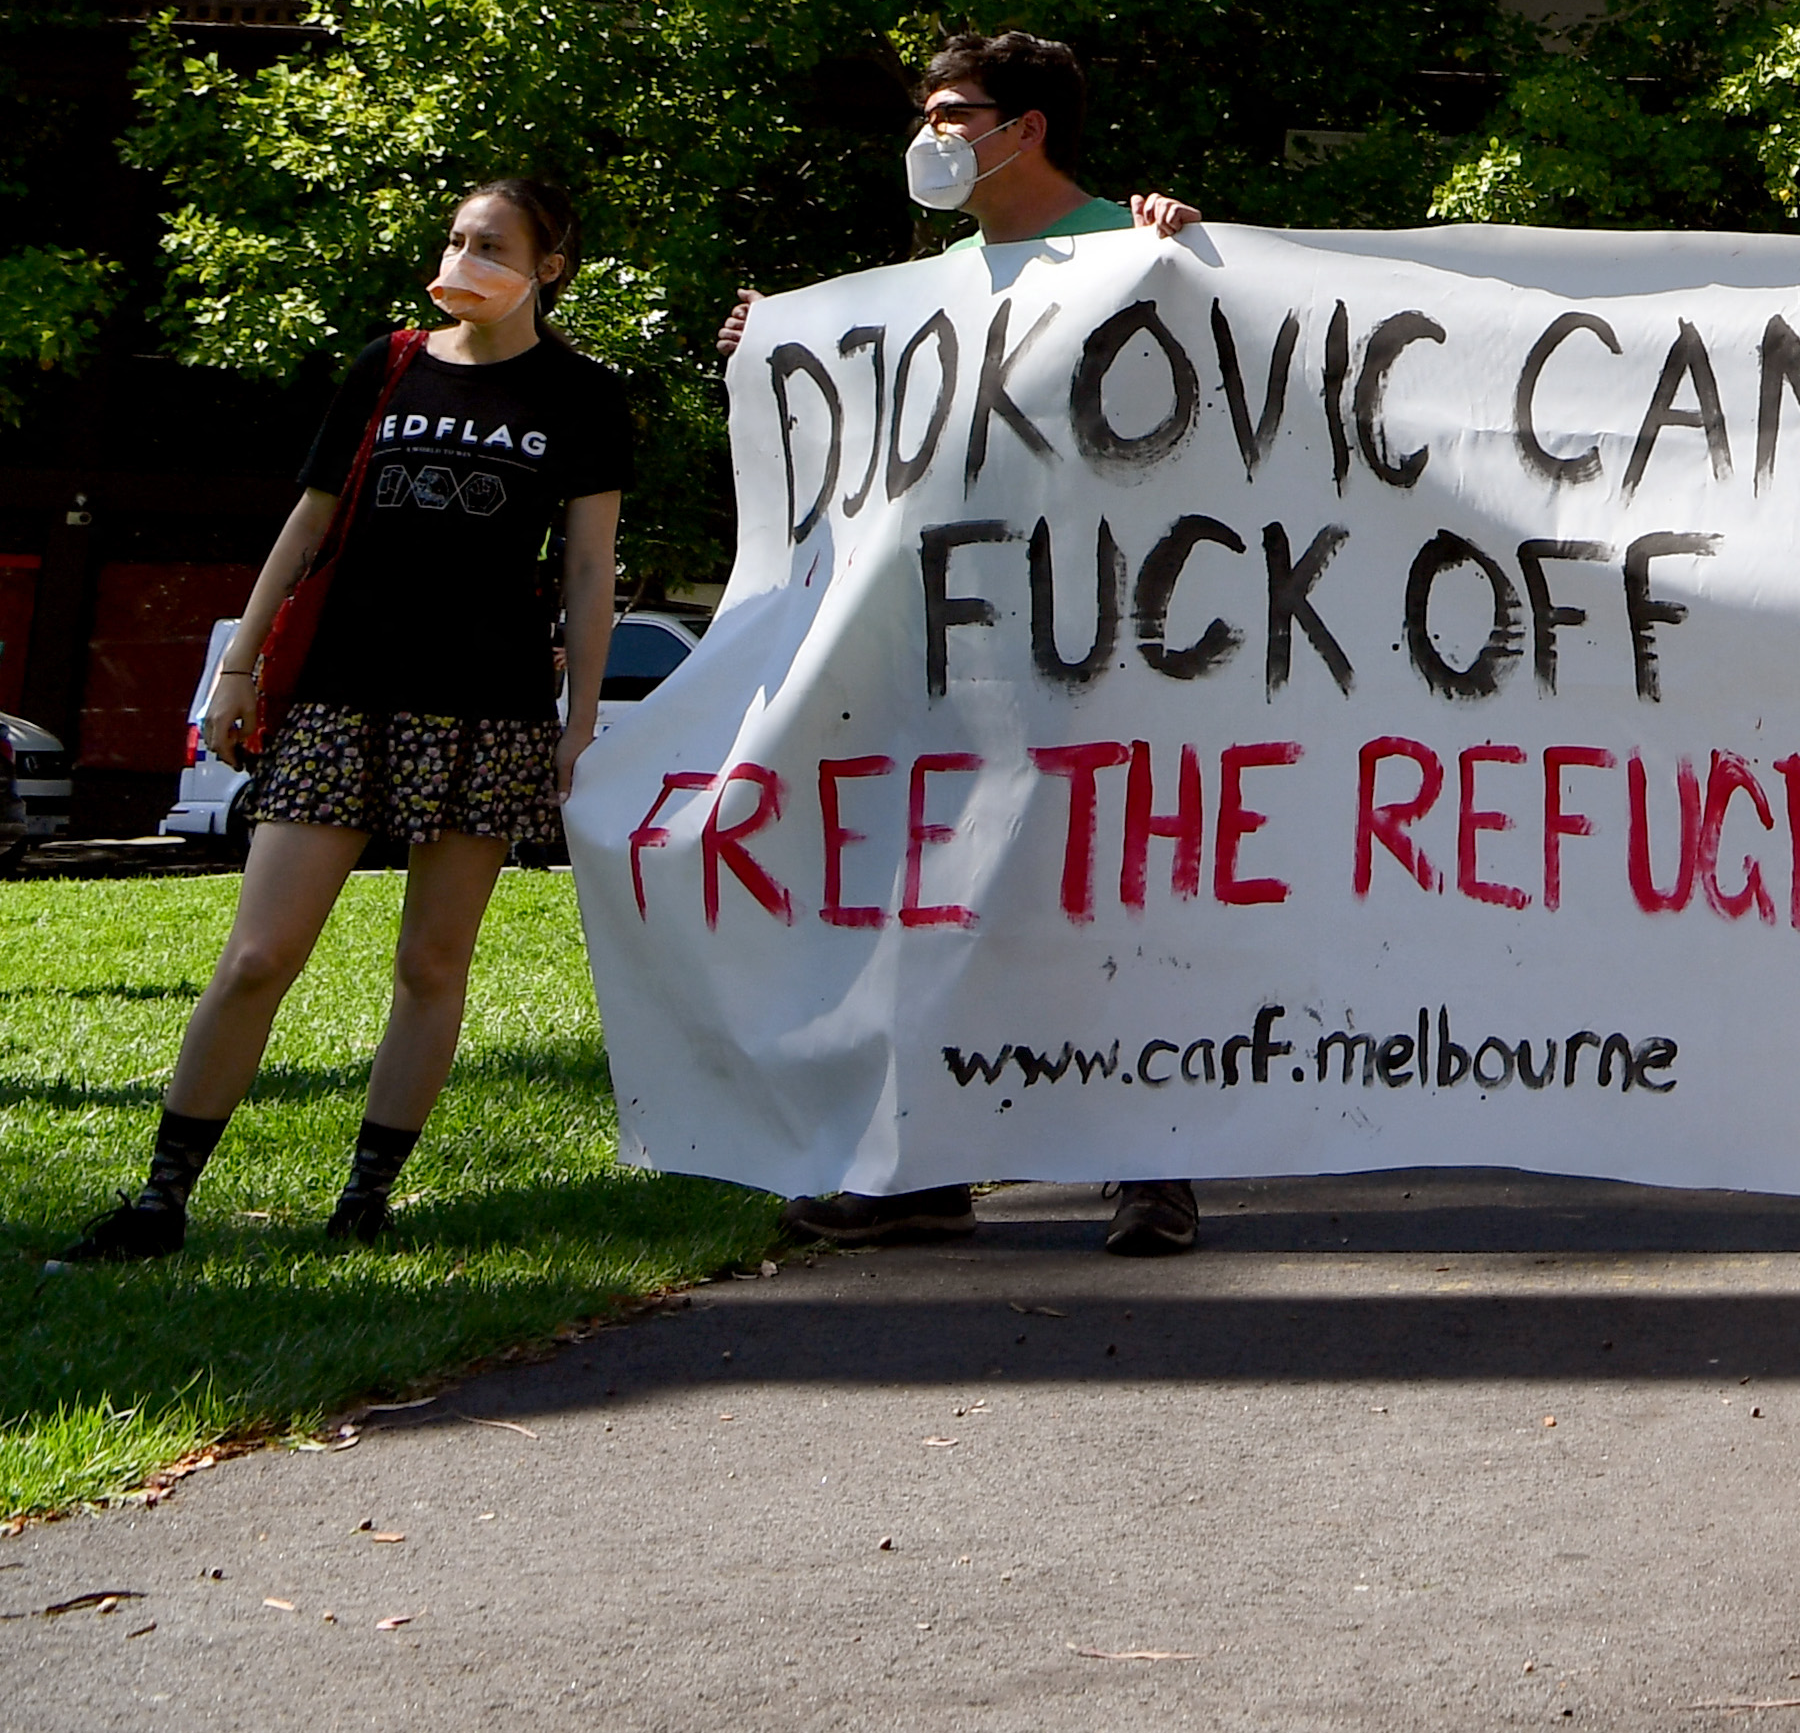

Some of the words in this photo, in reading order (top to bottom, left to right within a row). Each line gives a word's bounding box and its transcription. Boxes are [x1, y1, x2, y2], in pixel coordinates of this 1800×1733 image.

[769, 296, 1448, 546] DJOKOVIC
[919, 512, 1356, 701] FUCK
[1402, 527, 1724, 703] OFF
[627, 752, 983, 931] FREE
[1028, 739, 1305, 925] THE
[941, 1004, 1679, 1093] www.carf.melbourne
